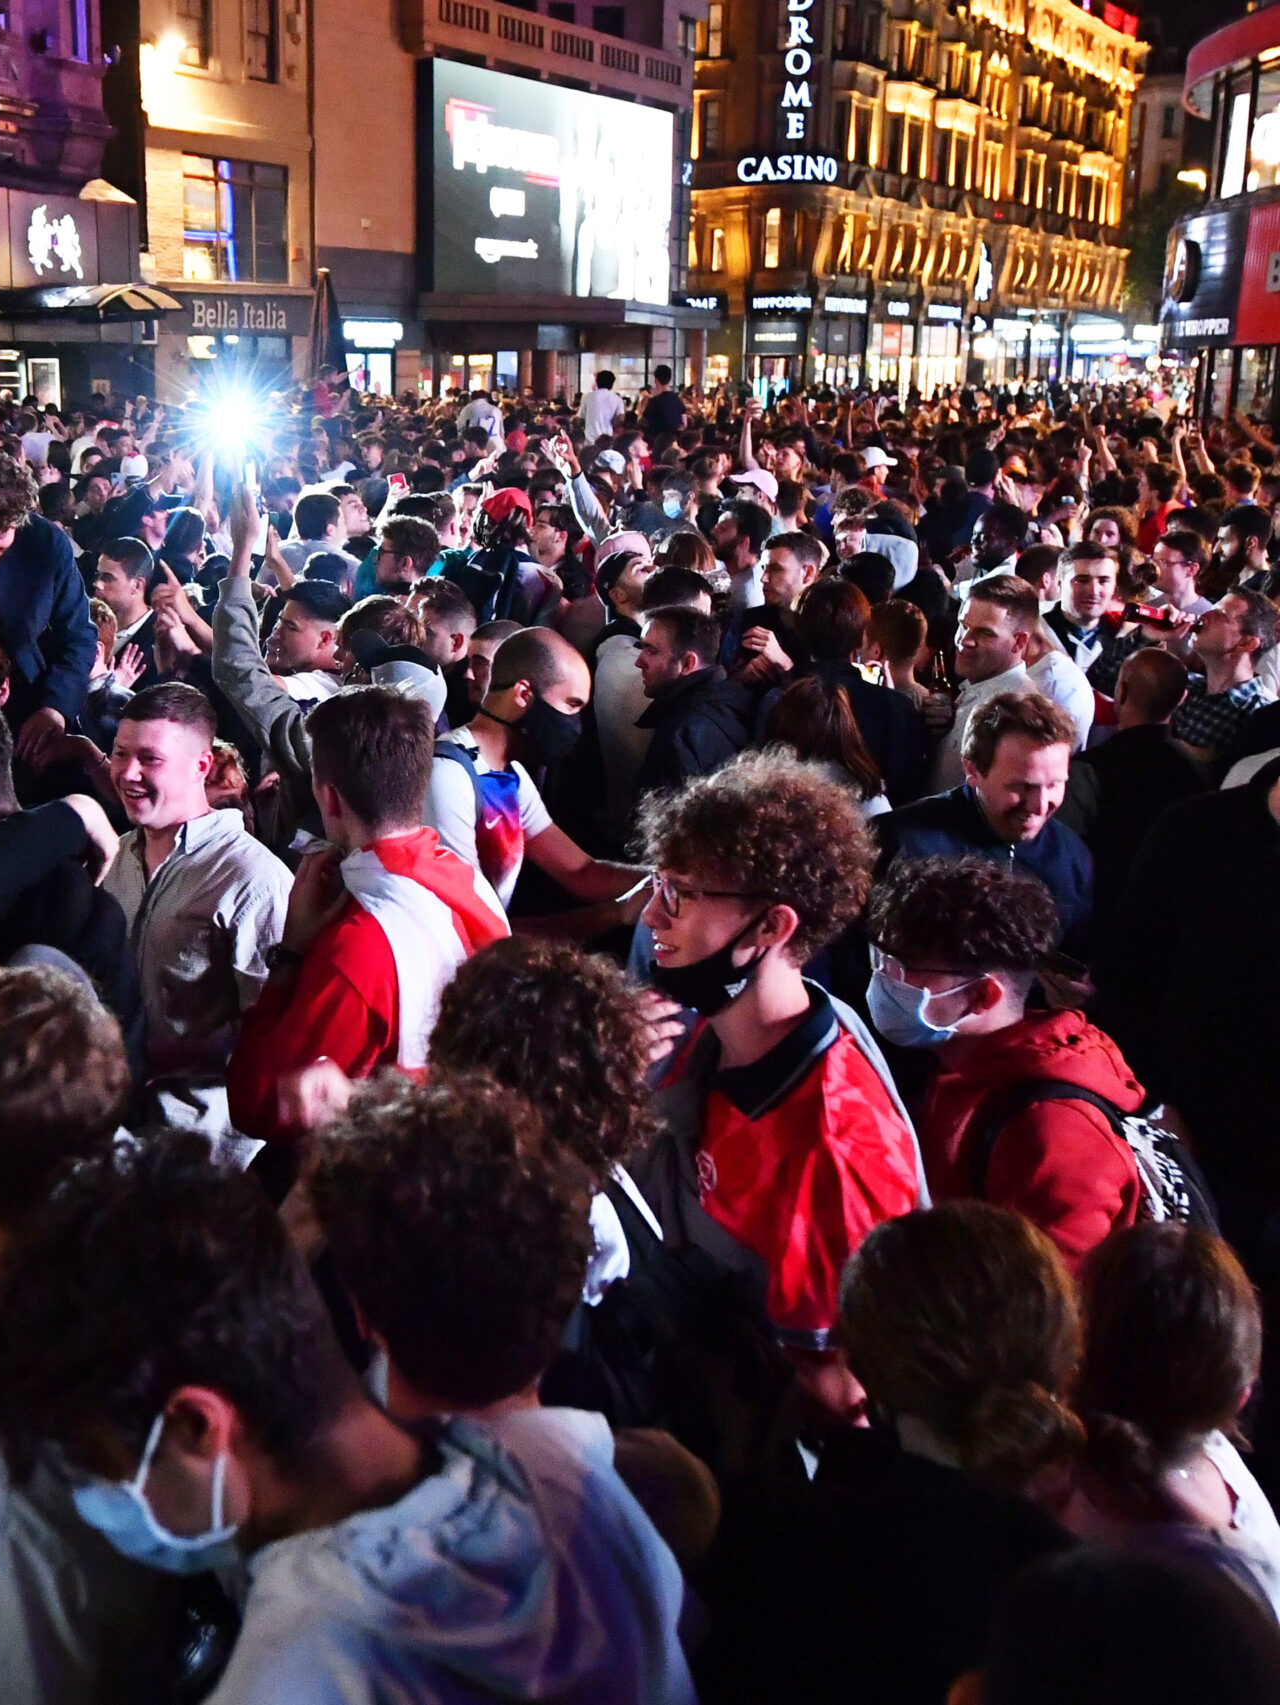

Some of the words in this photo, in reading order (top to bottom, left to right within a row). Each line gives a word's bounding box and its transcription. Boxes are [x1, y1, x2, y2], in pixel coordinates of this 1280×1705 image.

[737, 155, 838, 182] CASINO
[192, 300, 238, 328] Bella
[242, 302, 287, 329] Italia
[1185, 318, 1230, 336] WHOPPER
